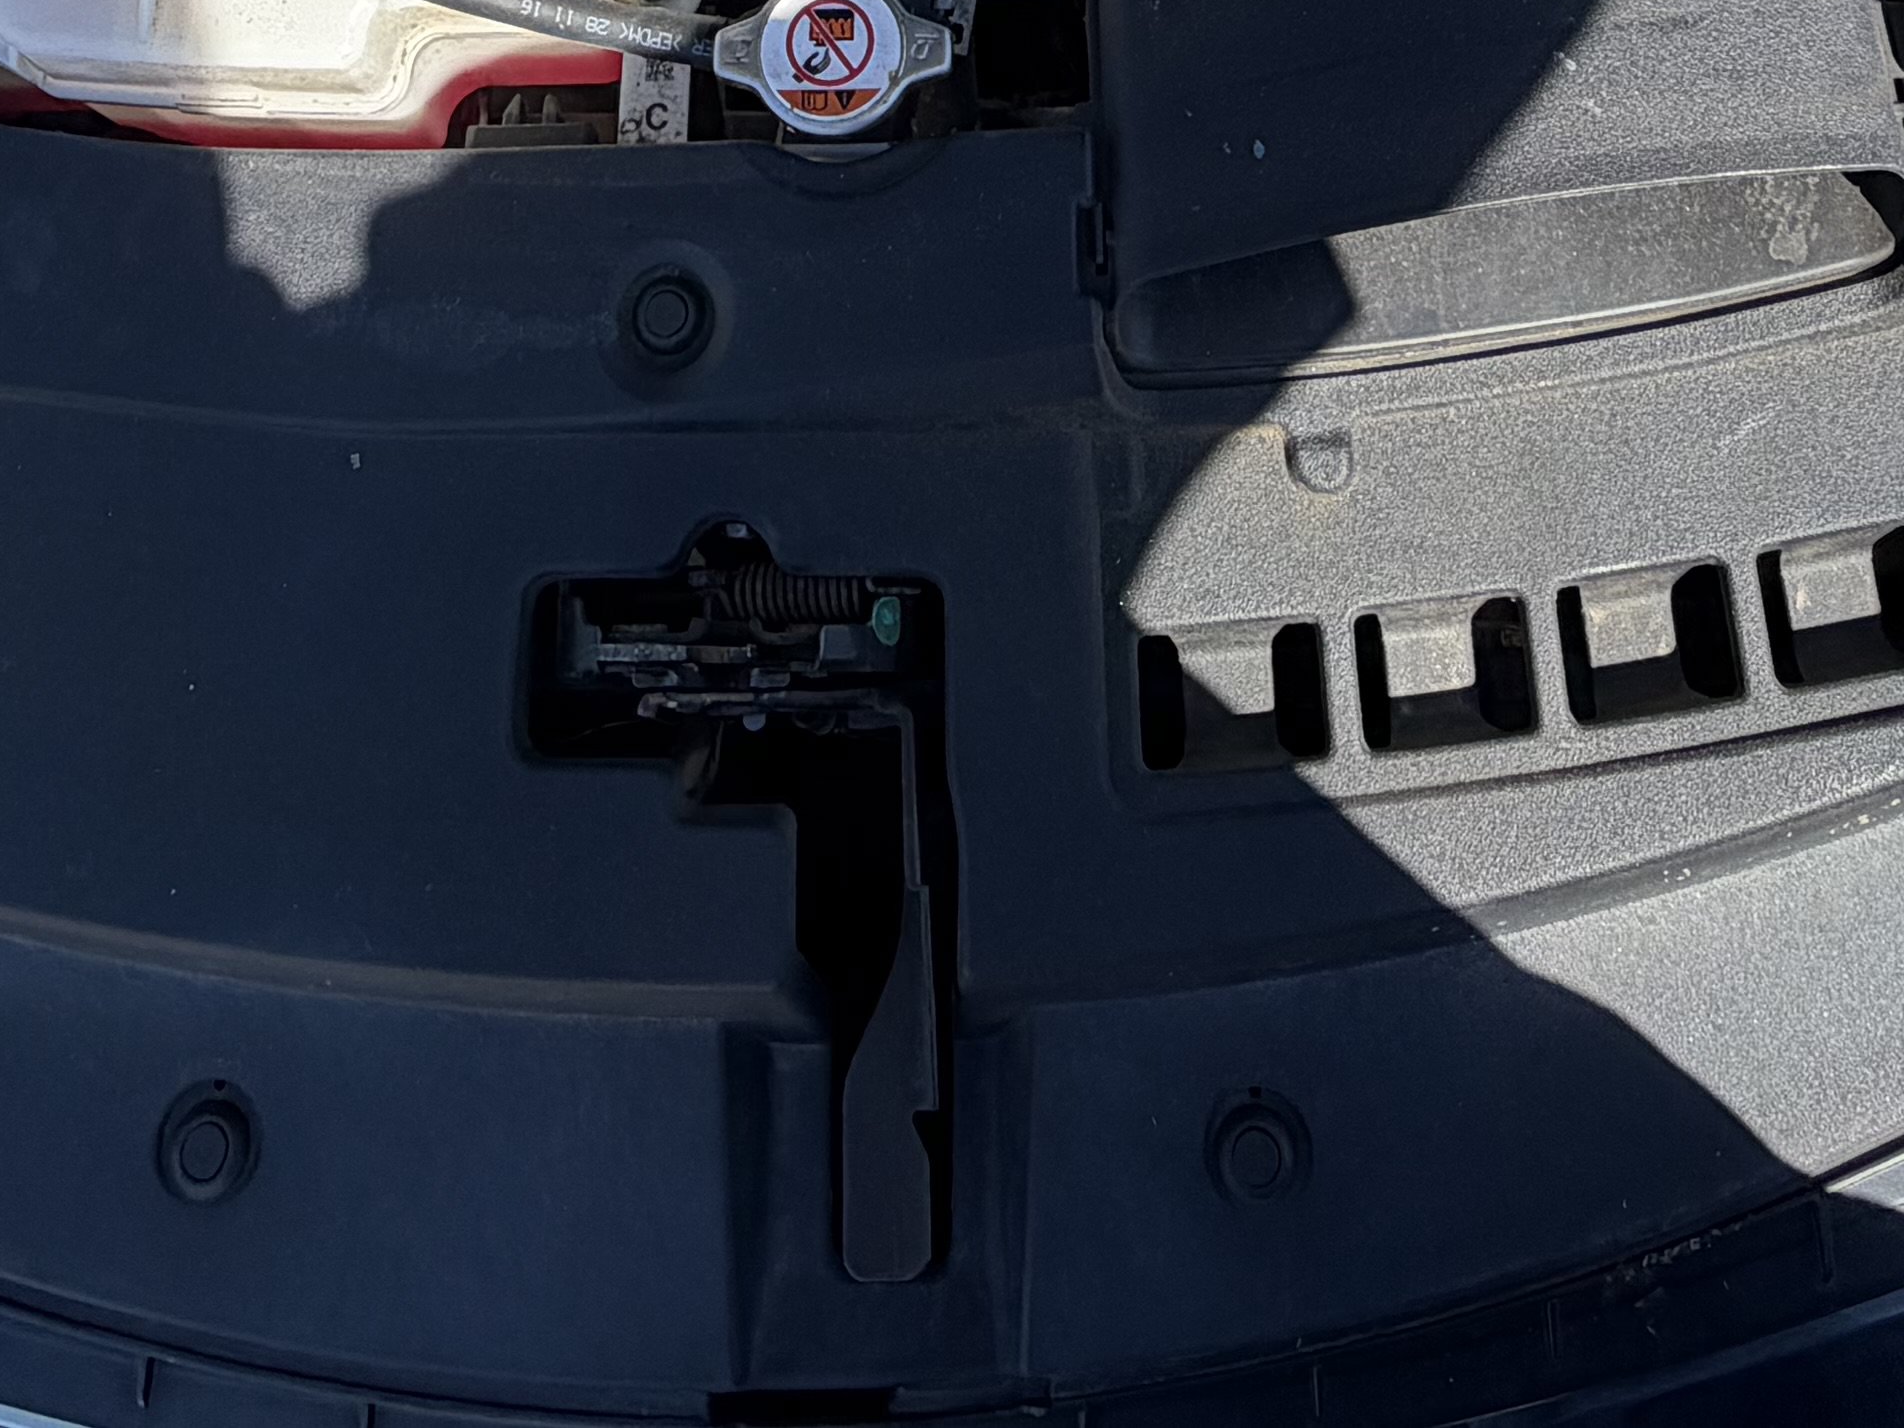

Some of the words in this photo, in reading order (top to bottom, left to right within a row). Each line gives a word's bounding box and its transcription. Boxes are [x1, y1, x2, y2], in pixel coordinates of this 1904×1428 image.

[555, 5, 575, 26] 11
[585, 15, 611, 35] 28
[645, 103, 668, 131] C
